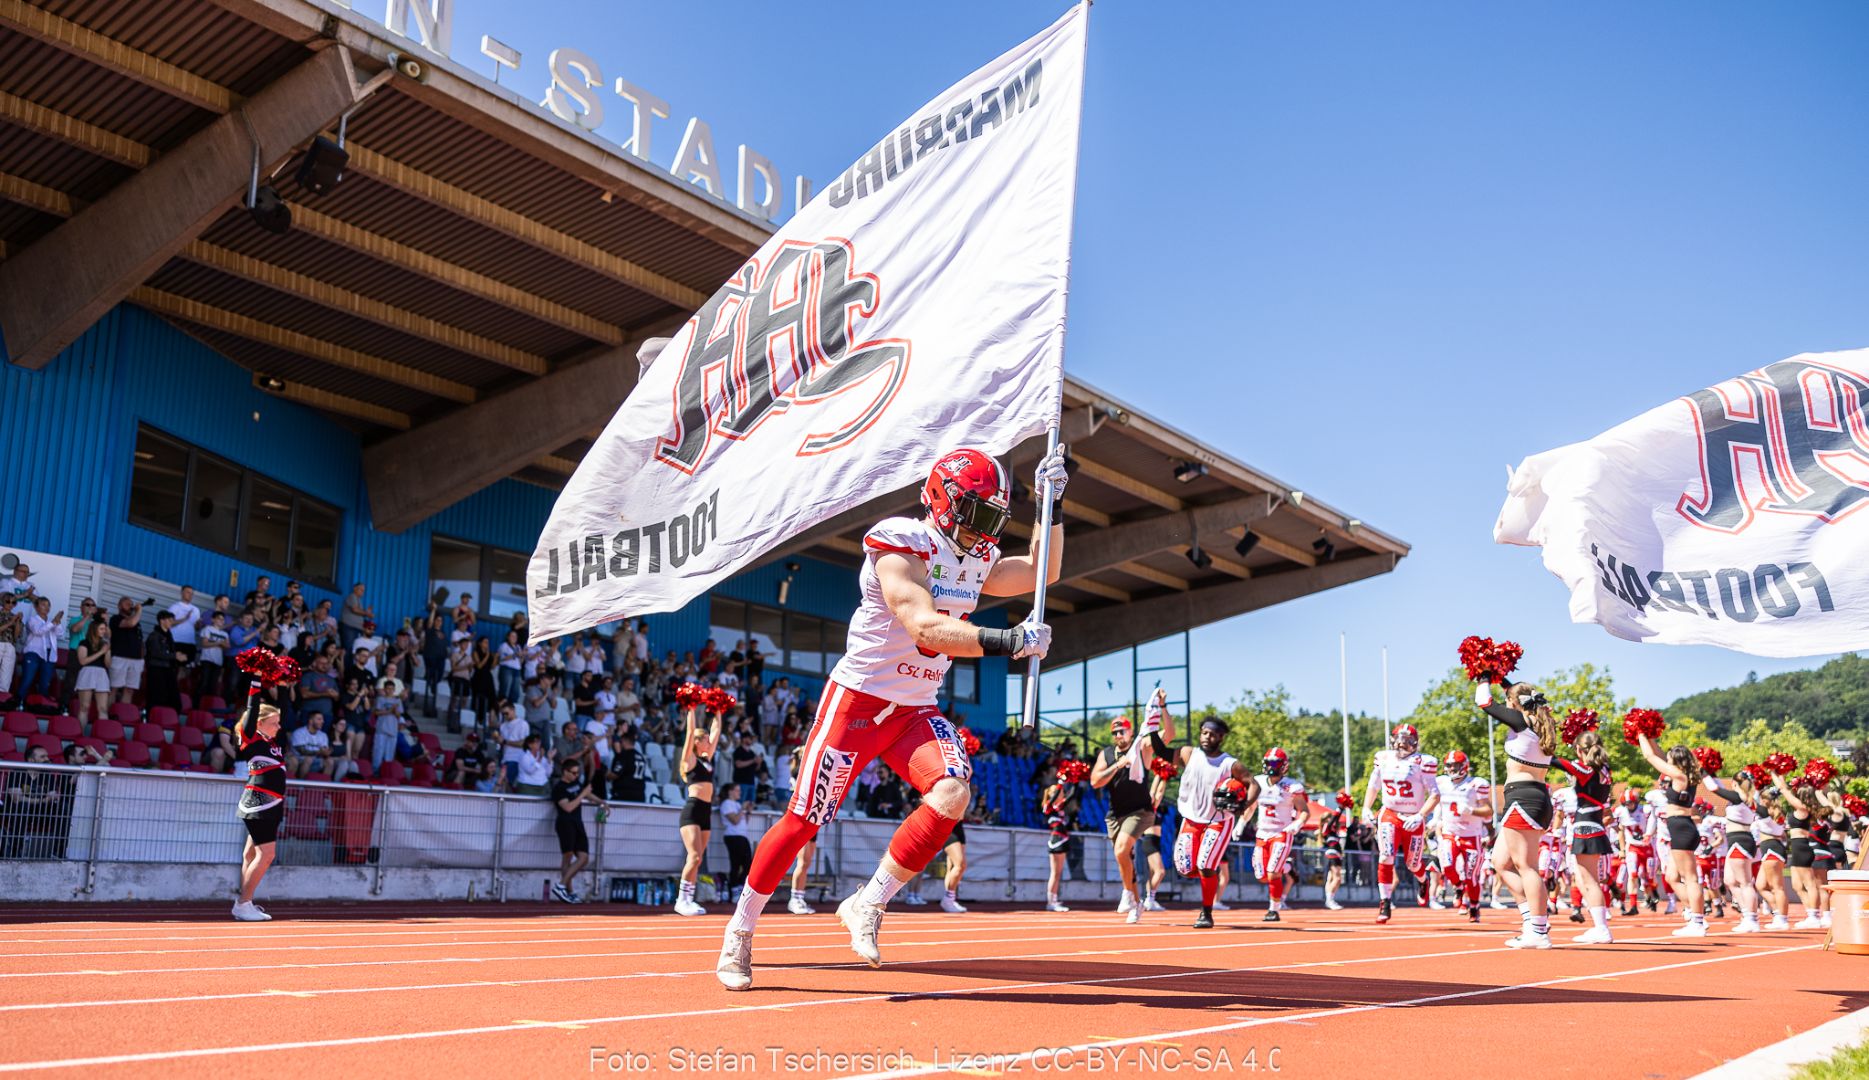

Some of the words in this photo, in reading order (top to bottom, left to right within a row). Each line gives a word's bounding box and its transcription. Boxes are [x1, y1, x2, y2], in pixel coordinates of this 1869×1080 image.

[897, 662, 920, 679] CSL
[633, 760, 645, 779] 17
[1383, 779, 1414, 798] 52
